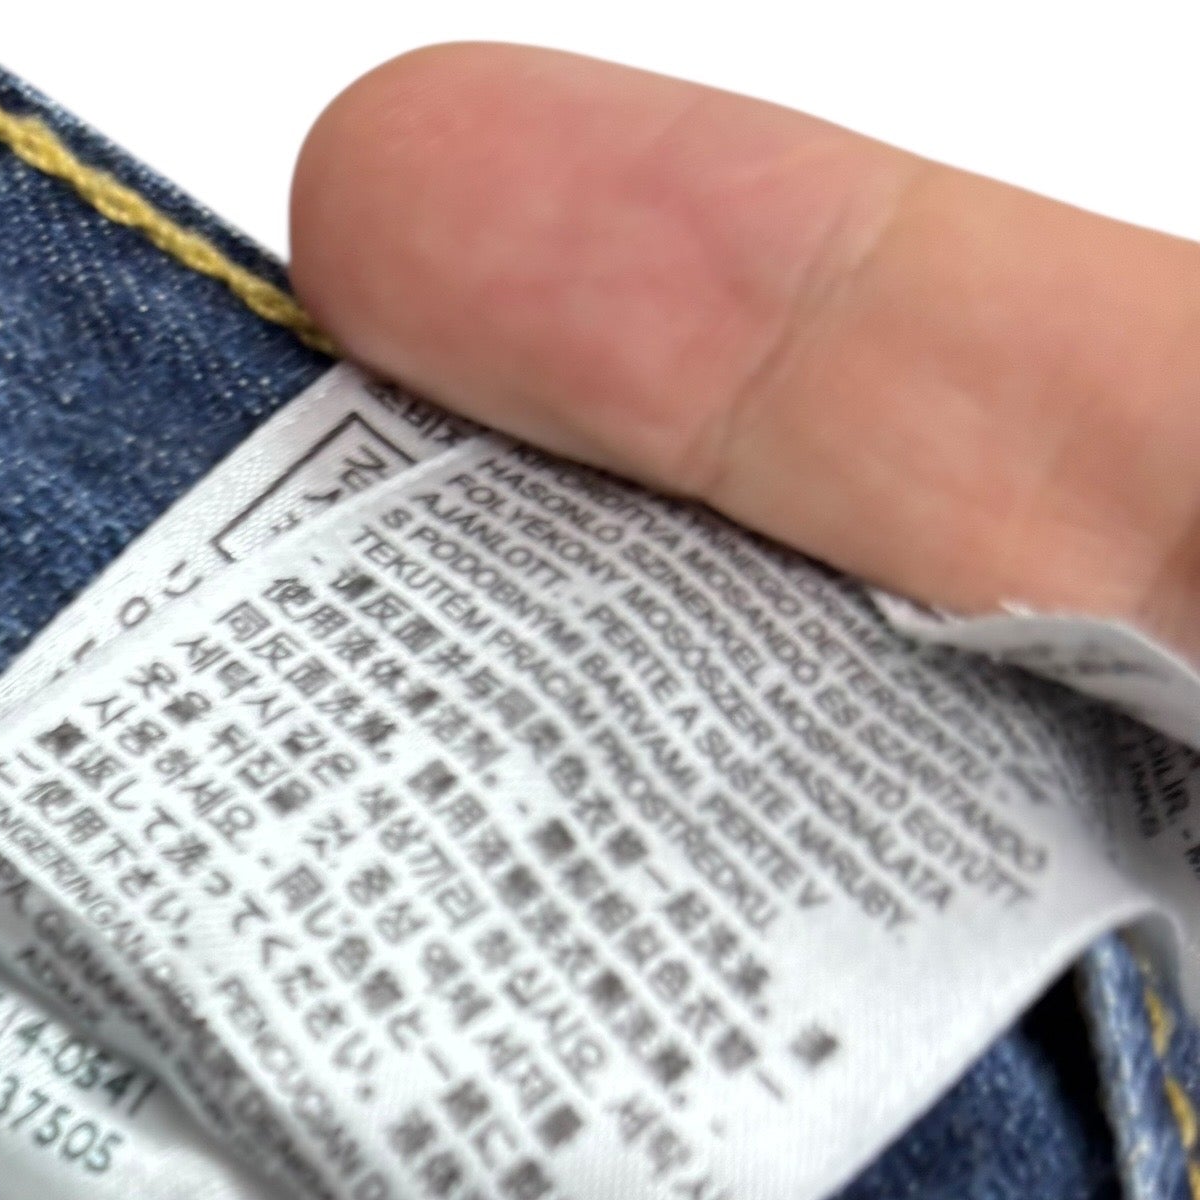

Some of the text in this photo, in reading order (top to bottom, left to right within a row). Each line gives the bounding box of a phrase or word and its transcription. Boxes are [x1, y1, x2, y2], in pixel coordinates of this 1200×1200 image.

[350, 525, 492, 635] TEKUTÉM
[444, 470, 630, 586] FOLYÉKONY
[379, 506, 414, 531] S
[696, 792, 805, 893] PERTE
[801, 880, 832, 910] V
[583, 604, 684, 706] PERTE
[666, 696, 704, 734] A
